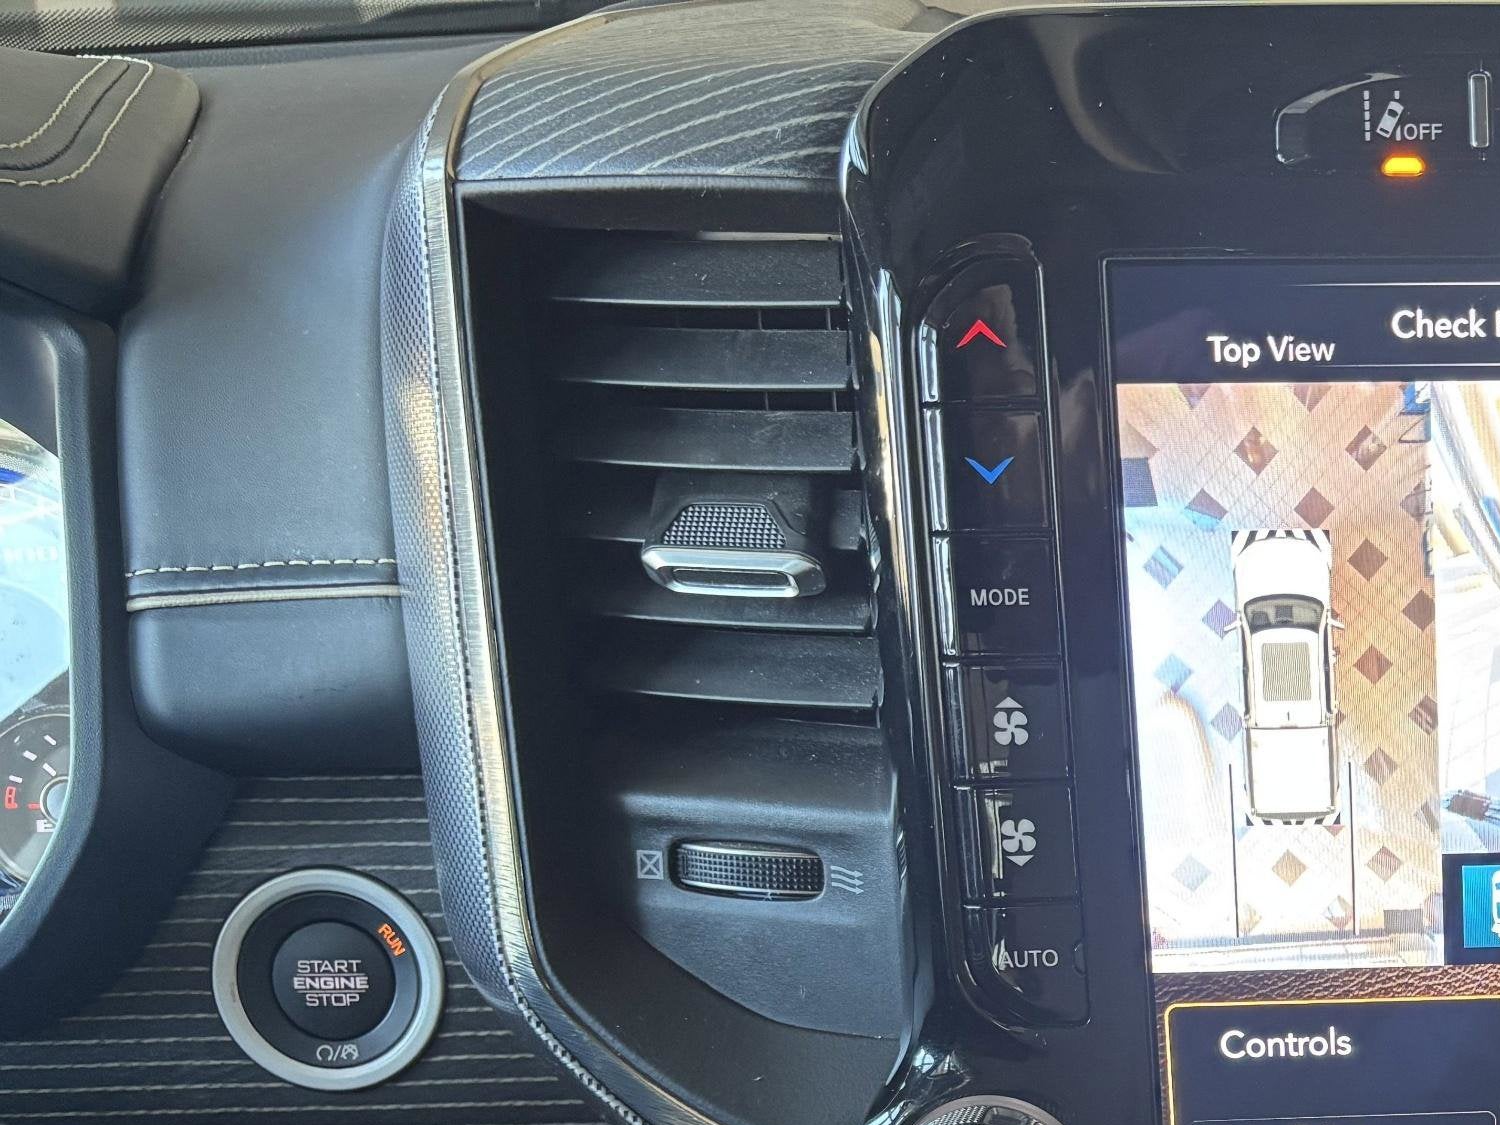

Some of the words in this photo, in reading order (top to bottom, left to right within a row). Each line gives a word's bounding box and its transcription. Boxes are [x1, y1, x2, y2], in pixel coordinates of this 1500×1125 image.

[1404, 123, 1443, 141] OFF
[1391, 309, 1487, 340] Check
[1207, 336, 1261, 365] Top
[1267, 336, 1335, 362] View
[971, 589, 1030, 606] MODE
[378, 923, 406, 957] RUN
[297, 960, 361, 973] START
[1000, 949, 1058, 968] AUTO
[294, 977, 369, 989] ENGINE
[306, 993, 360, 1007] STOP
[1220, 1027, 1352, 1059] Controls
